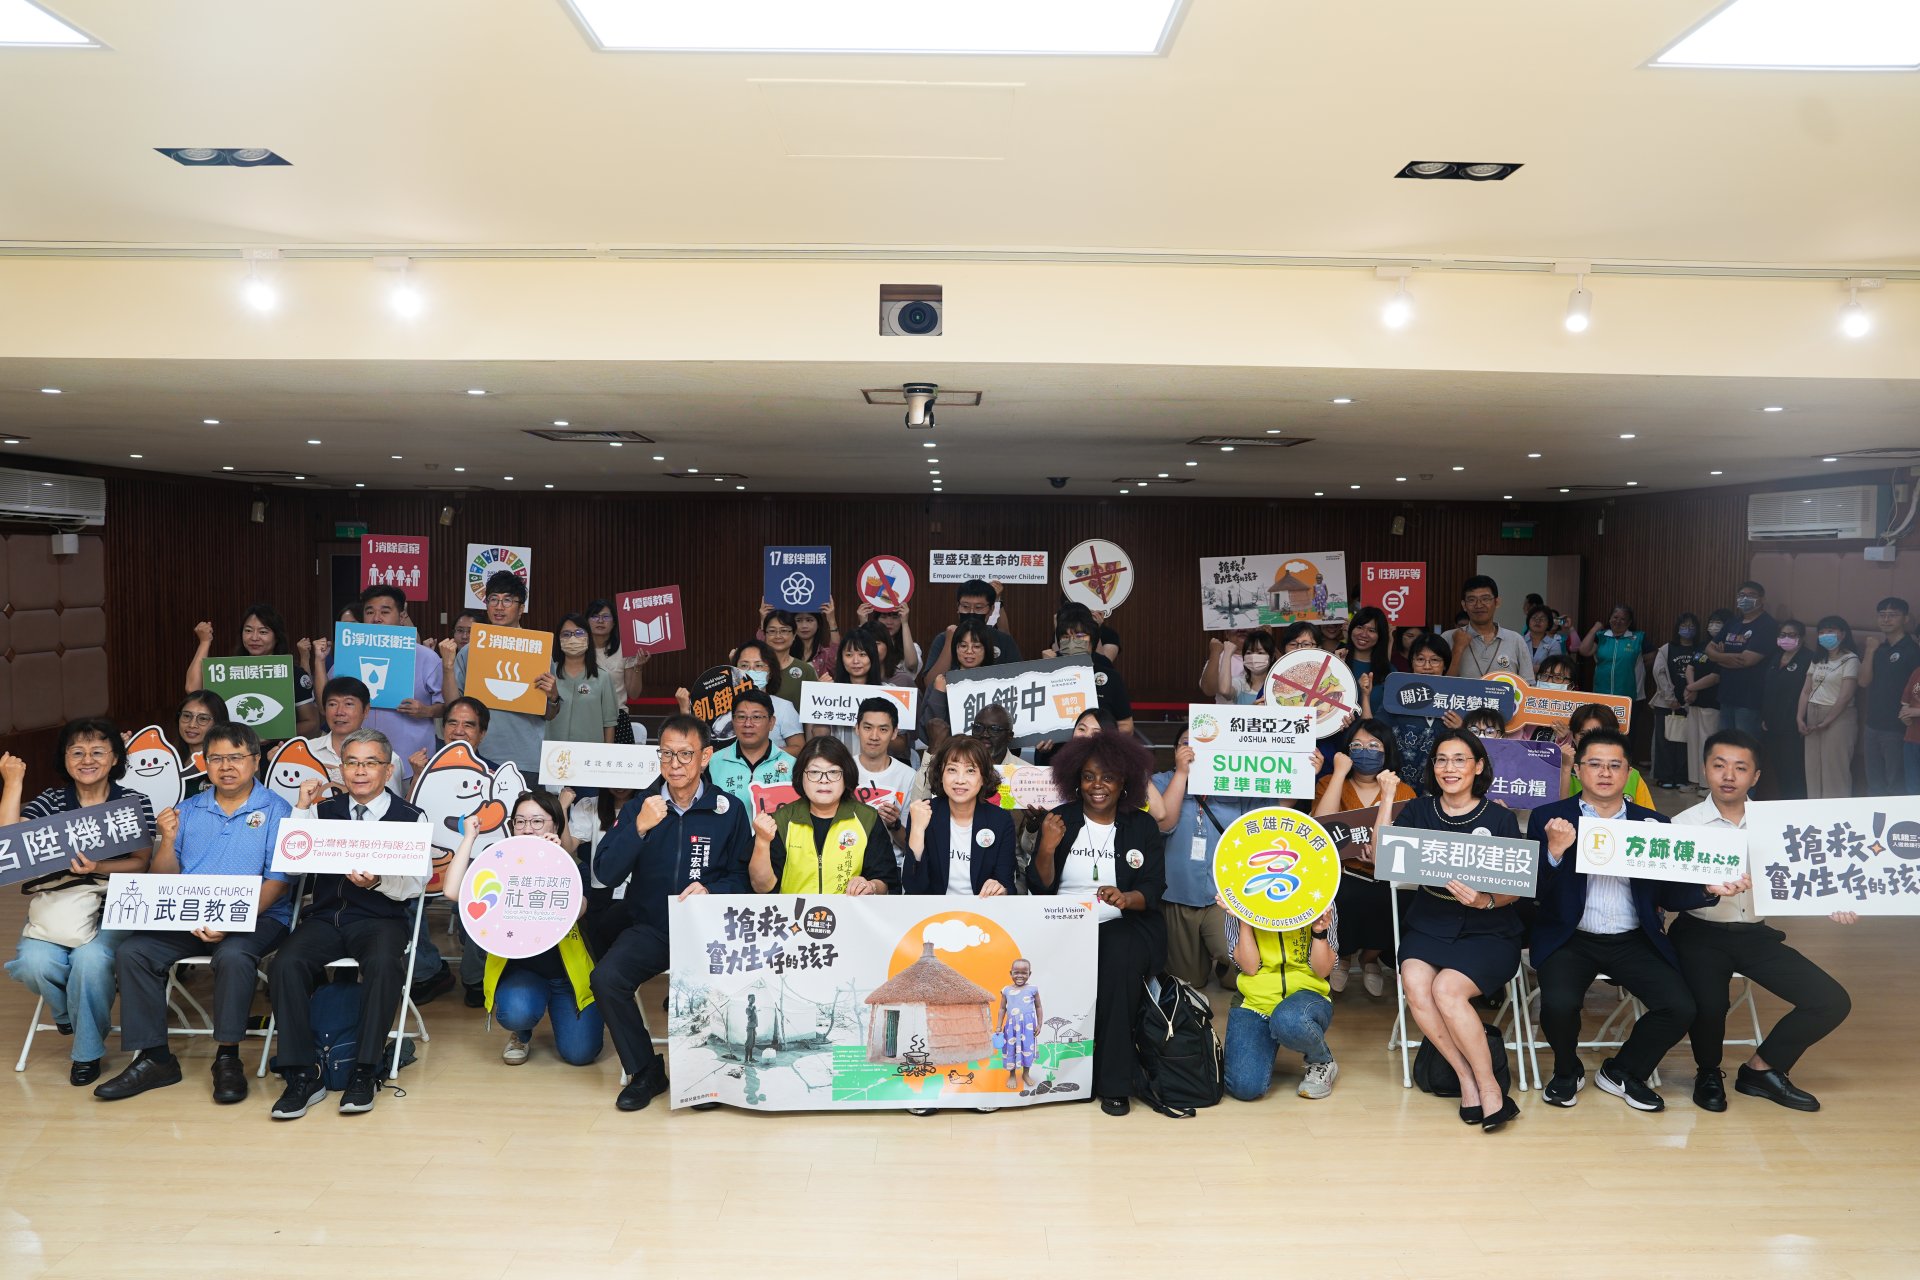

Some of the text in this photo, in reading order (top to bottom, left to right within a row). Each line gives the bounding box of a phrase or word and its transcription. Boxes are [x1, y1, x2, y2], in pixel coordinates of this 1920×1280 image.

[367, 539, 420, 555] 1 消除貧窮
[770, 551, 827, 566] 17 夥伴關係
[932, 553, 1045, 567] 豐盛兒童生命的展望
[1367, 567, 1421, 581] 5 性別平等
[622, 593, 674, 612] 4 優質教育
[342, 628, 416, 650] 6 淨水及衛生
[476, 630, 543, 654] 2 消除飢餓
[208, 664, 289, 683] 13 氣候行動
[812, 694, 852, 708] World
[963, 681, 1046, 733] 飢餓中
[1061, 696, 1078, 706] 請勿
[1525, 697, 1626, 717] 高雄市政局
[1230, 717, 1310, 734] 約書亞之家
[1271, 736, 1296, 744] HOUSE
[584, 760, 644, 769] 建設有限公司
[1212, 754, 1292, 774] SUNON
[1213, 776, 1292, 794] 建準電機
[1244, 816, 1328, 852] 高雄市政府
[1332, 826, 1372, 845] 止戰
[1592, 834, 1606, 850] F
[1782, 812, 1887, 865] 搶救!
[286, 840, 307, 850] 台糖
[314, 838, 426, 852] 台灣糖業股份有限公司
[1098, 850, 1115, 859] Vis
[1625, 836, 1741, 867] 方師傅點心坊
[312, 850, 424, 860] Taiwan Sugar Corporation
[689, 844, 703, 880] 王宏榮
[957, 850, 970, 862] Vis
[1421, 838, 1533, 876] 泰郡建設
[508, 875, 572, 888] 高雄市政府
[843, 850, 853, 894] 高雄市政
[1420, 869, 1530, 888] TAIJUN CONSTRUCTION
[1765, 862, 1920, 900] 奮力生存的孩
[158, 885, 254, 897] WU CHANG CHURCH
[504, 889, 570, 910] 社會局
[154, 898, 251, 923] 武昌教會
[1224, 887, 1316, 927] KAOHSIUNG CITY GOVERNMENT
[724, 897, 806, 943] 搶救!
[706, 940, 839, 975] 奮力生存的孩子
